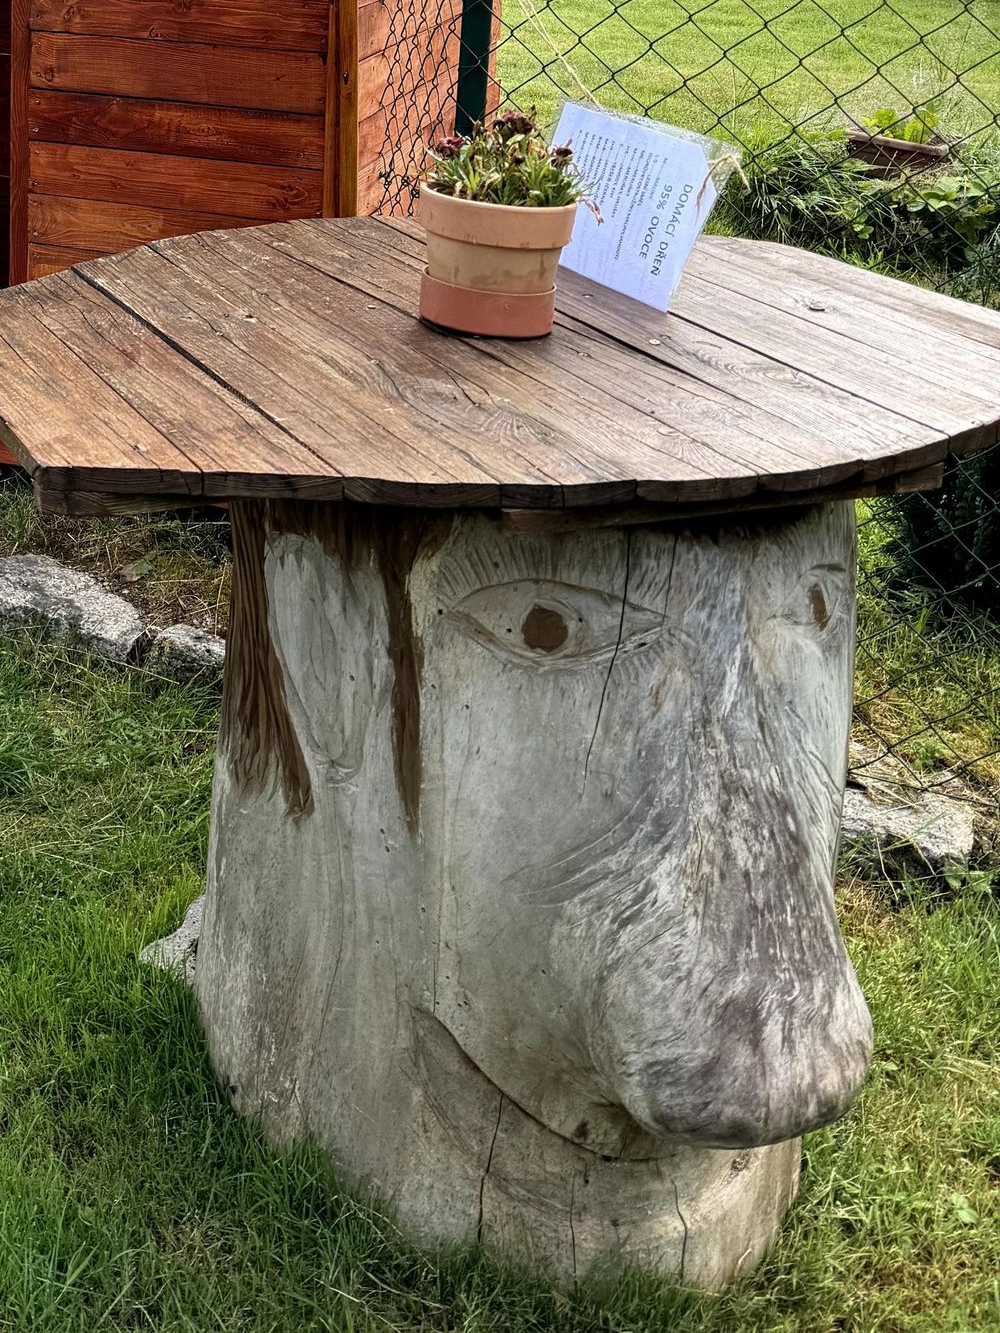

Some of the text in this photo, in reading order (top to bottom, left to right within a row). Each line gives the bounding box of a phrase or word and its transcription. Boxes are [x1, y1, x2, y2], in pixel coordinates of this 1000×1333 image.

[639, 183, 673, 259] 95% OVOCE
[650, 183, 693, 277] DOMÁCÍ DŘEŇ
